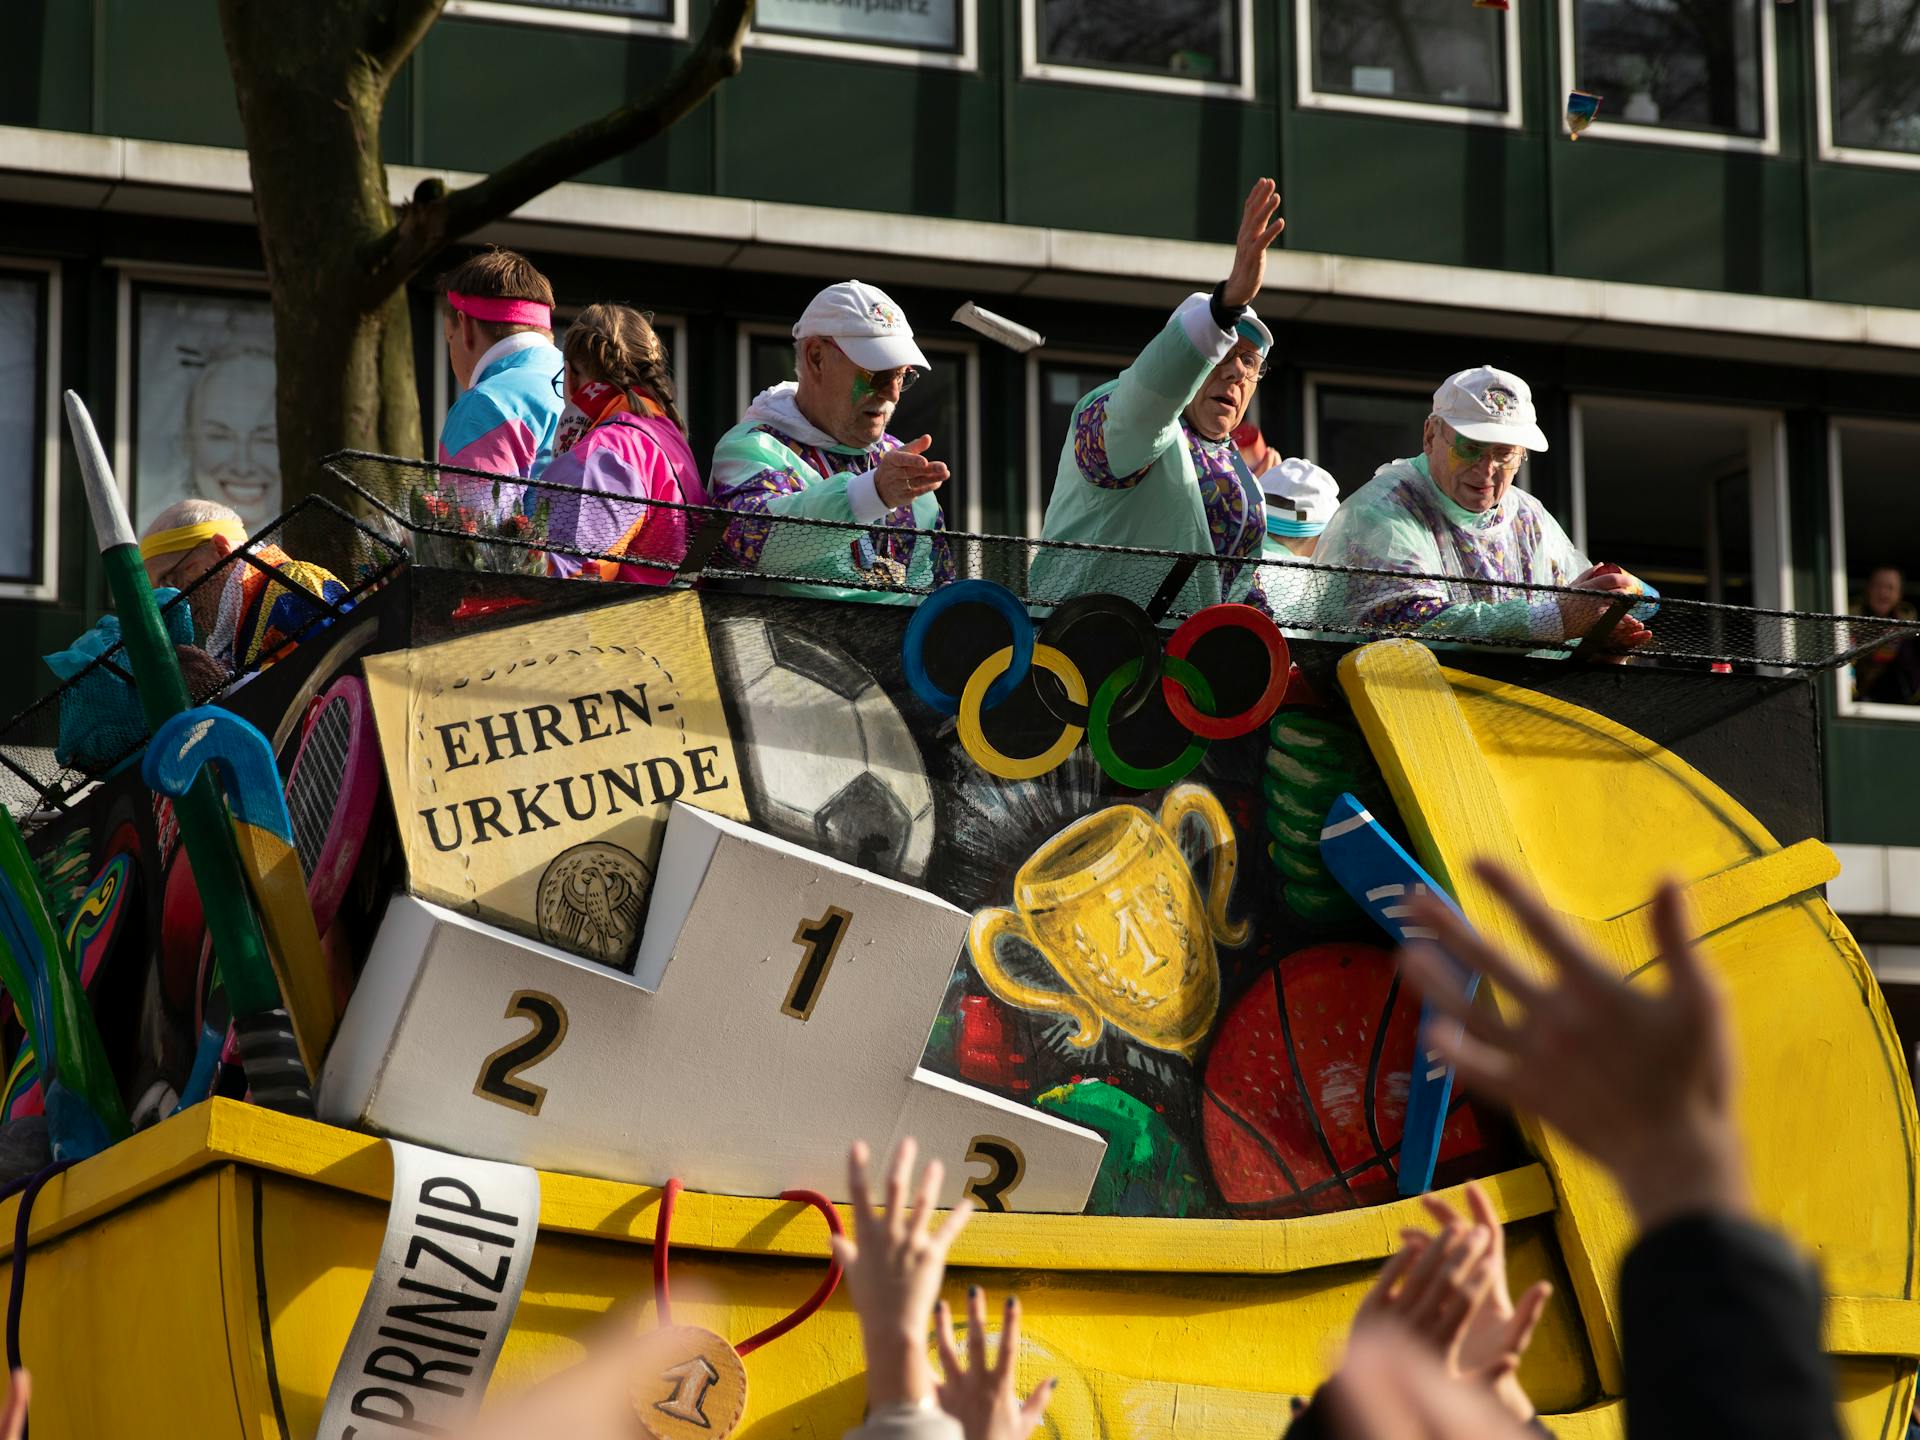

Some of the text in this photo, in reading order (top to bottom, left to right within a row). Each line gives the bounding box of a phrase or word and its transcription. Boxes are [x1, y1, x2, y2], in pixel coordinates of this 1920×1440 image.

[435, 683, 674, 772] EHREN-
[418, 746, 728, 852] URKUNDE
[780, 905, 854, 1021] 1
[472, 988, 569, 1117] 2
[340, 1176, 519, 1440] PRINZIP
